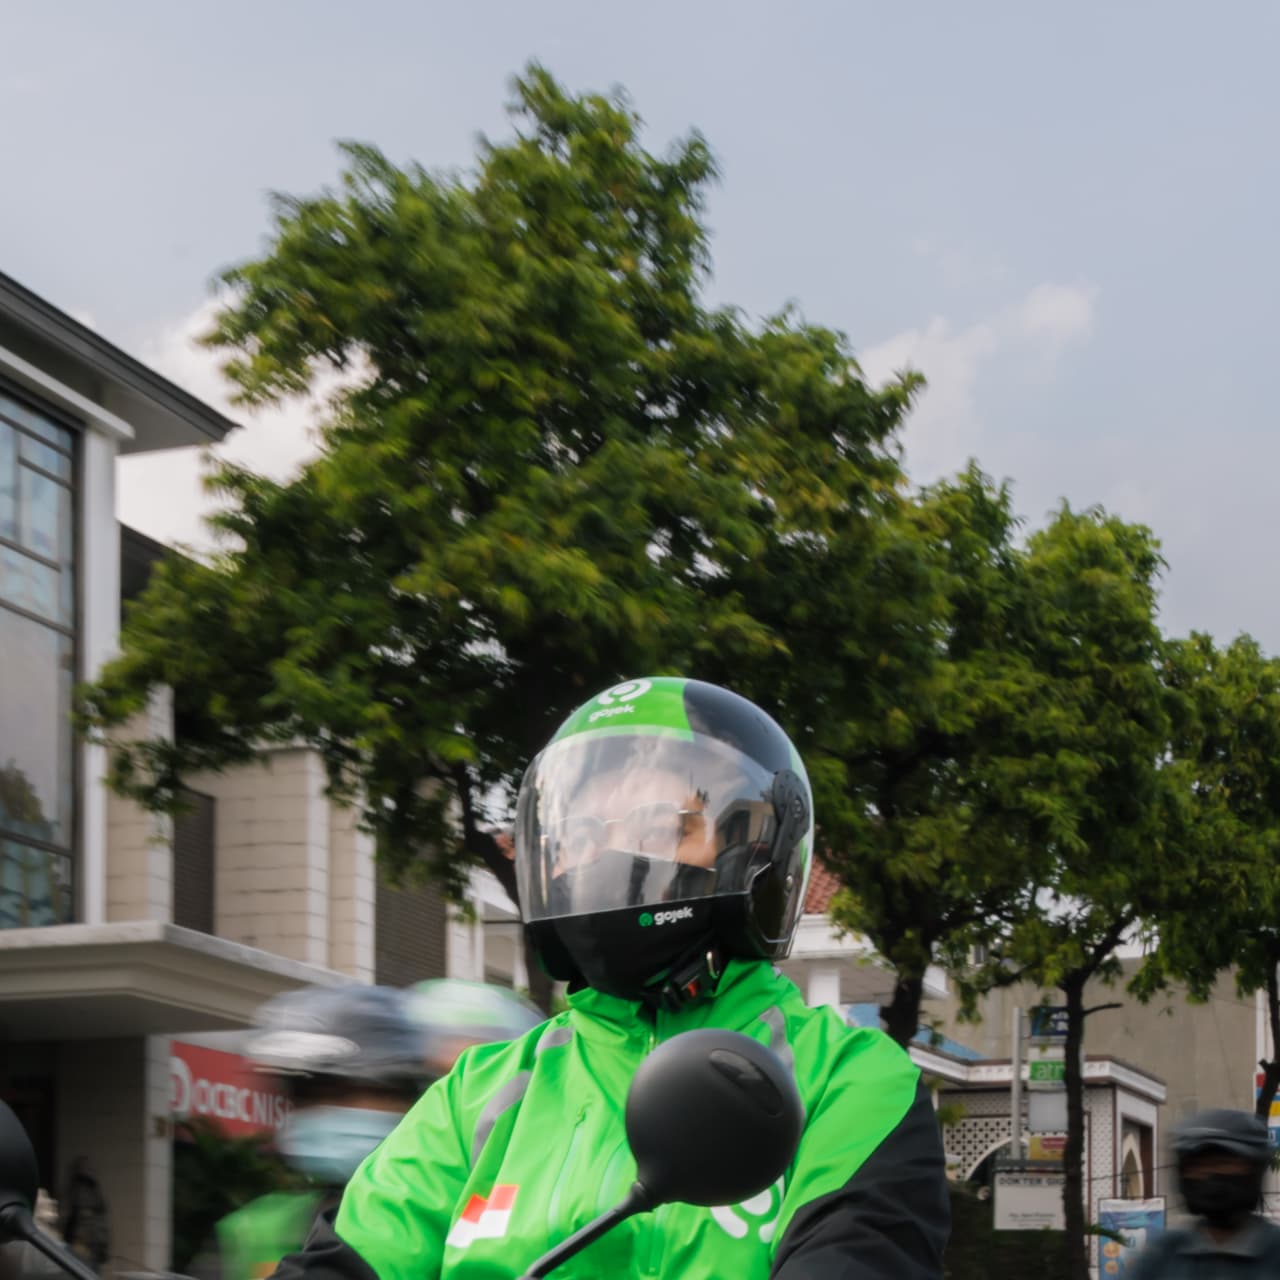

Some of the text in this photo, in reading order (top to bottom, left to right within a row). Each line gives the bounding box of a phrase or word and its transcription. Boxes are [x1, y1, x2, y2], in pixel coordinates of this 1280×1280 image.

[588, 704, 635, 723] gojek
[653, 906, 694, 926] gojek
[194, 1078, 250, 1122] OCBC
